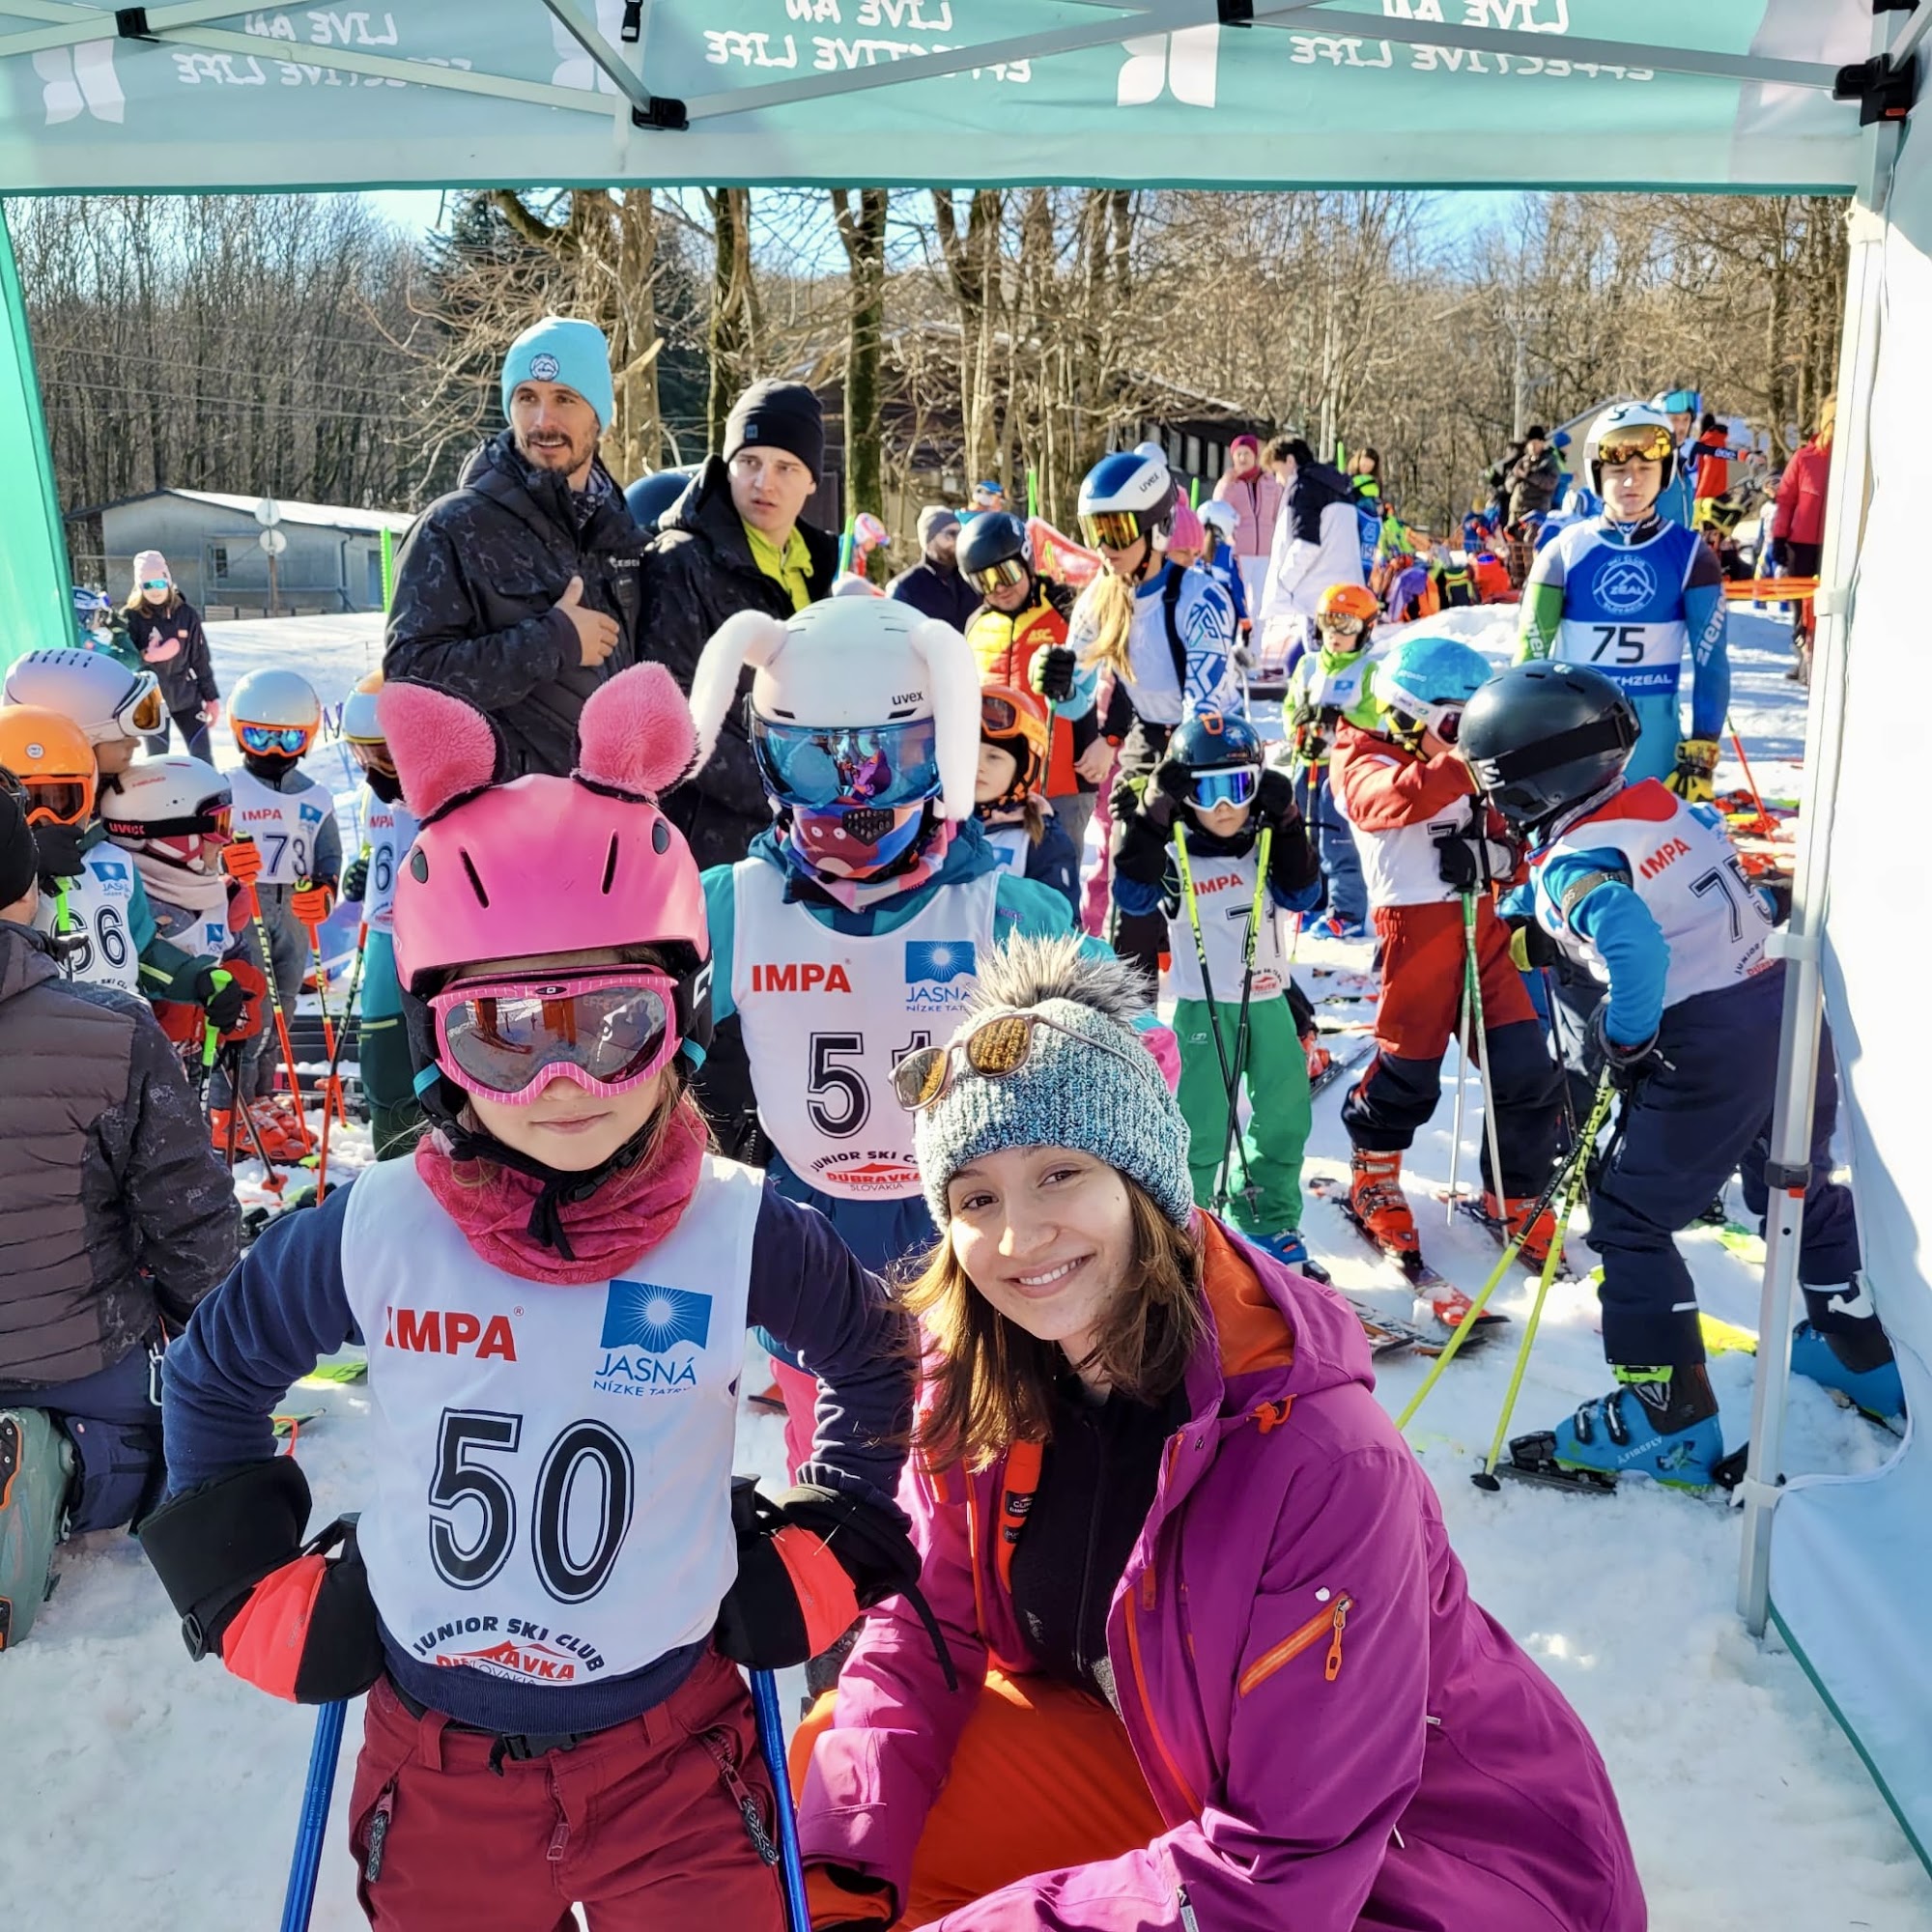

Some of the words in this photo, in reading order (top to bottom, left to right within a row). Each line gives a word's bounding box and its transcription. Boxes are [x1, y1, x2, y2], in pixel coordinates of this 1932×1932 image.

[1590, 625, 1645, 665] 75
[1695, 595, 1727, 668] ziene
[1613, 673, 1673, 687] THZEAL
[892, 691, 924, 706] uvex
[242, 808, 283, 822] IMPA
[262, 831, 307, 878] 73
[1638, 838, 1692, 881] IMPA
[1193, 872, 1244, 897] IMPA
[1225, 899, 1281, 964] 71
[752, 963, 852, 994] IMPA
[809, 1151, 861, 1173] JUNIOR
[867, 1150, 897, 1160] SKI
[849, 1181, 904, 1193] SLOVAKIA
[595, 1352, 696, 1385] JASNÁ
[593, 1379, 644, 1397] NÍZKE
[428, 1406, 635, 1605] 50
[412, 1615, 499, 1657] JUNIOR
[506, 1617, 550, 1641] SKI
[554, 1633, 606, 1673] CLUB
